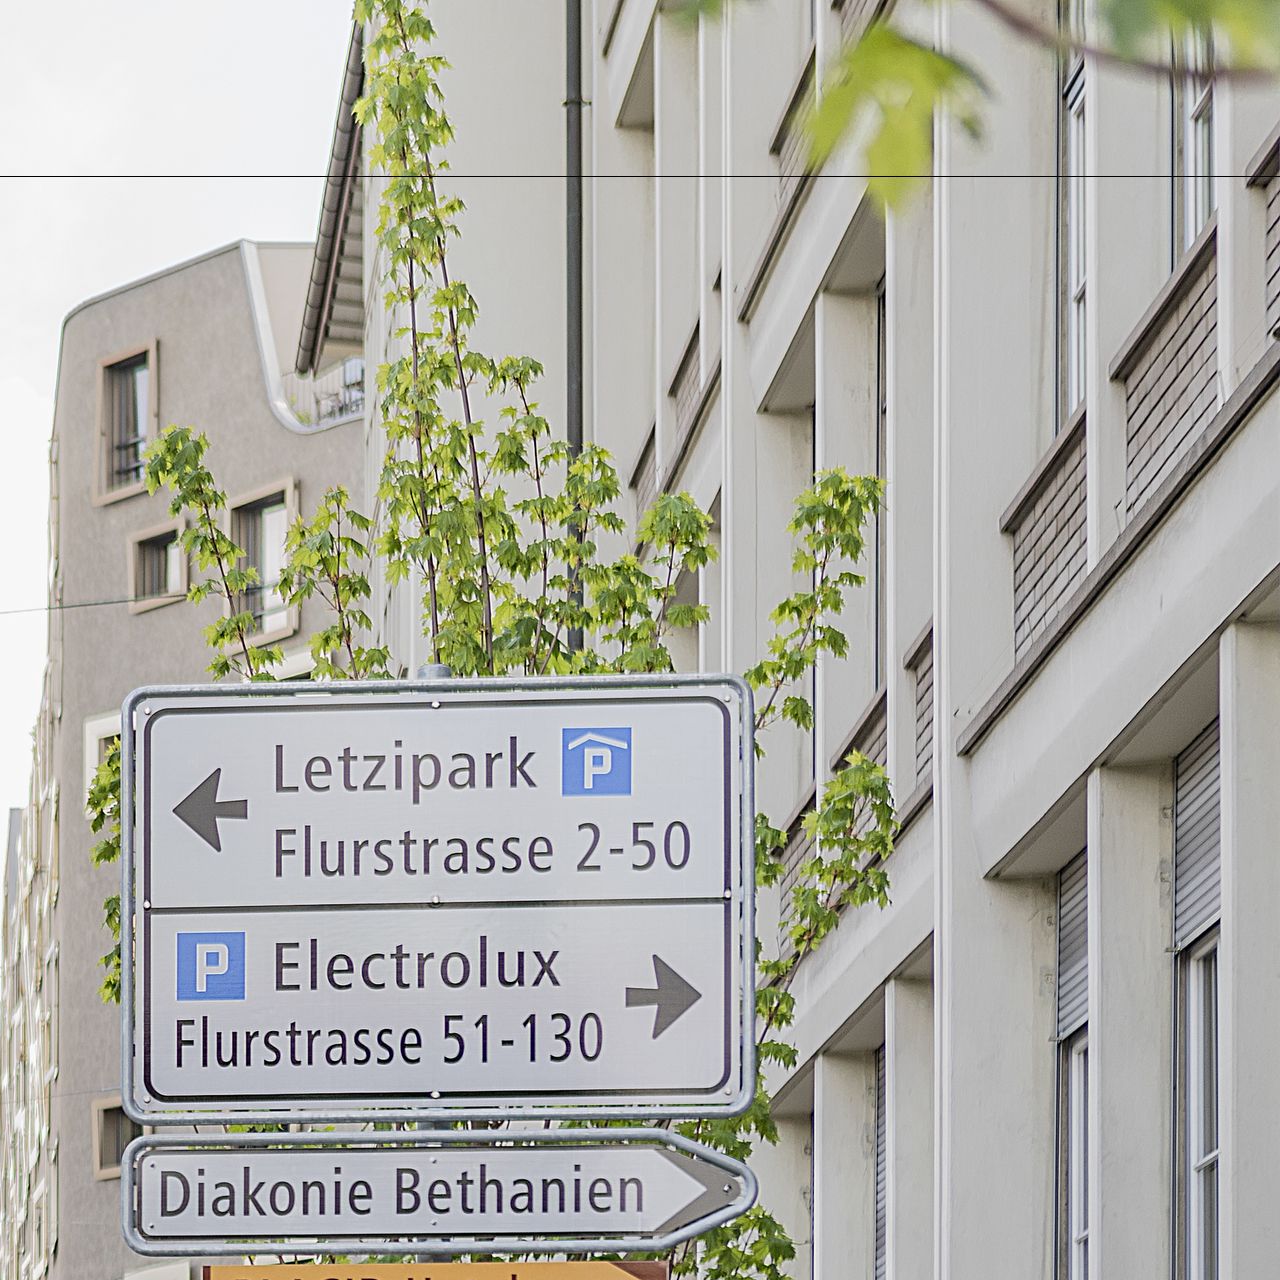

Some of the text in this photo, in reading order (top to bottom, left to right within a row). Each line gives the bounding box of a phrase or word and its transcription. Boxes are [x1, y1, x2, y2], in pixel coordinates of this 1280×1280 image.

[274, 736, 611, 805] Letzipark P
[274, 820, 691, 877] Flurstrasse 2-50
[196, 935, 561, 992] P Electrolux
[175, 1011, 604, 1068] Flurstrasse 51-130
[159, 1163, 644, 1218] Diakonie Bethanien
